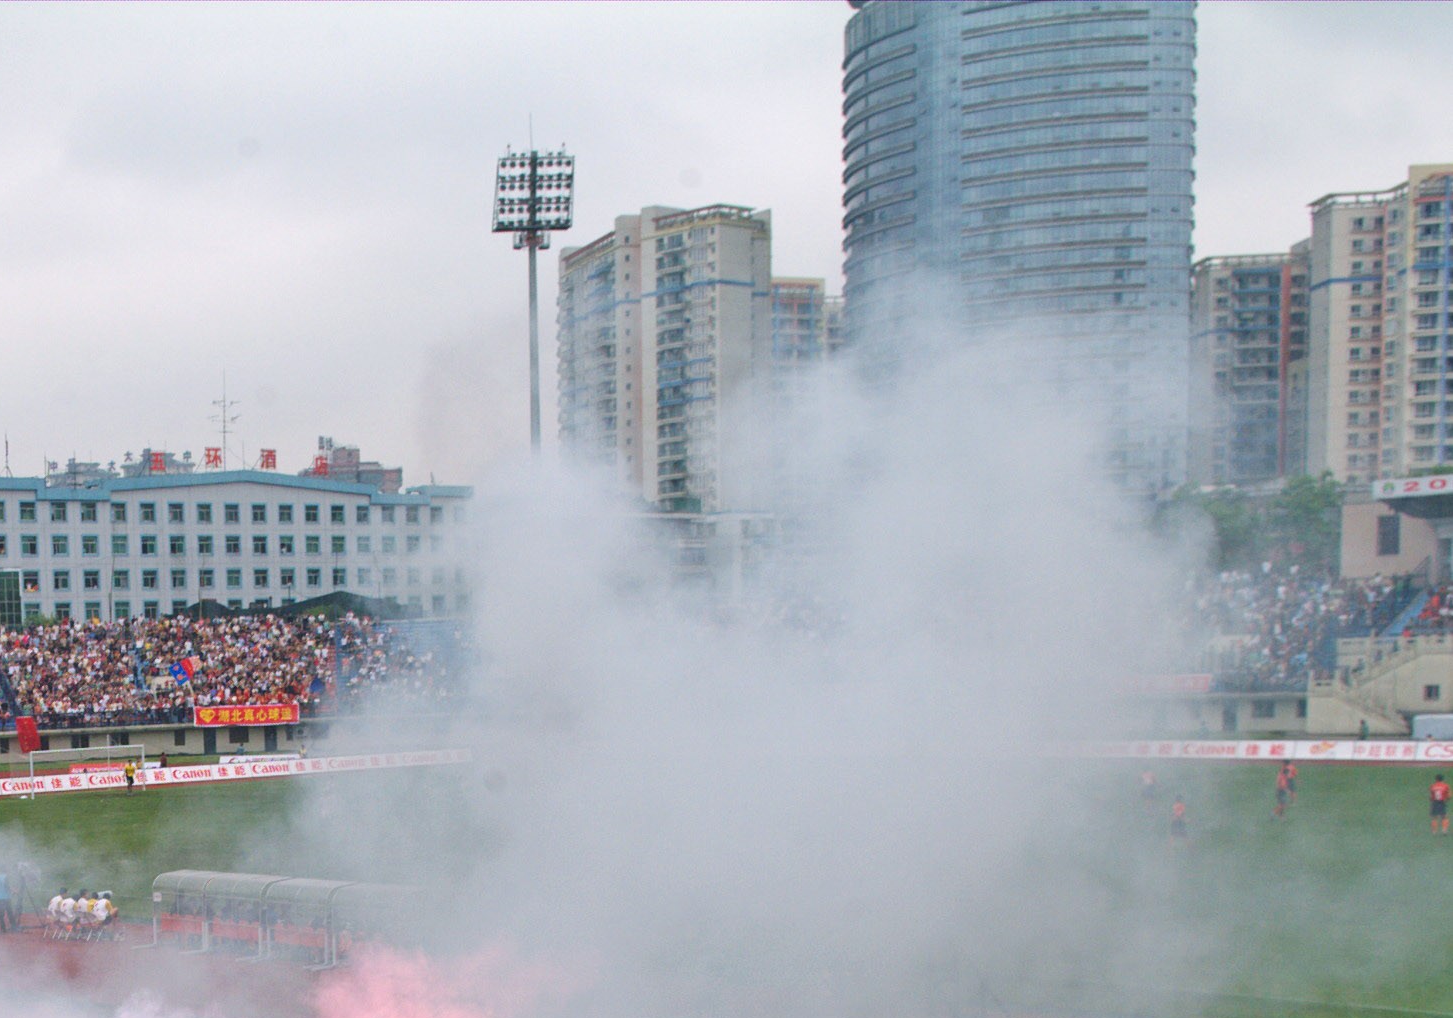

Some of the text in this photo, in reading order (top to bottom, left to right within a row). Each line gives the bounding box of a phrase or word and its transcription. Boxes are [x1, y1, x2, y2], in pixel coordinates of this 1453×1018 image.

[150, 446, 329, 476] 五环酒店
[218, 707, 292, 722] 湖北真心球迷
[1246, 743, 1285, 756] 佳能
[1, 779, 44, 793] Canon
[51, 776, 82, 789] 佳能
[172, 766, 211, 779] Canon
[218, 763, 246, 777] 佳能
[252, 760, 289, 774] Canon
